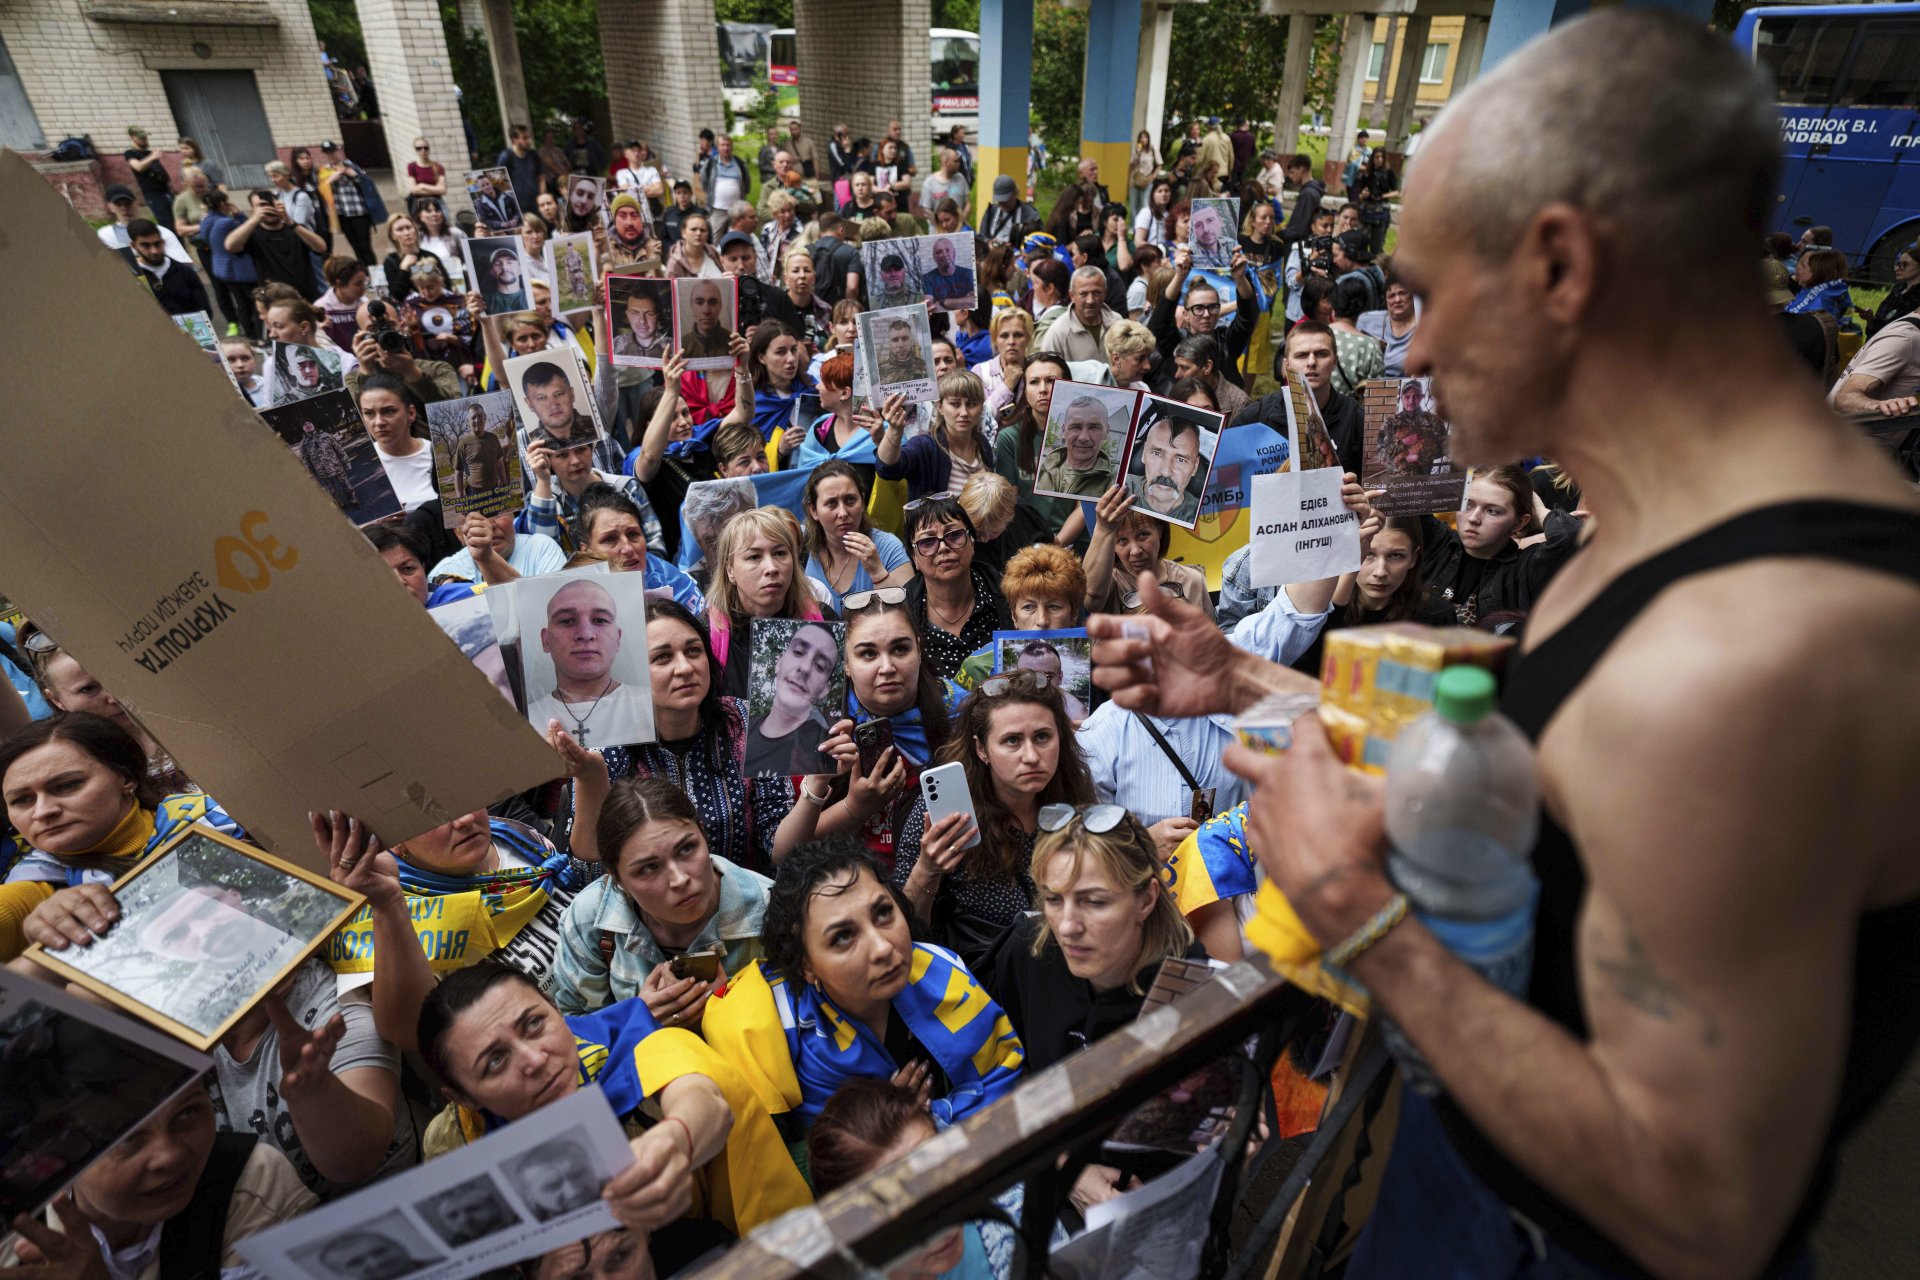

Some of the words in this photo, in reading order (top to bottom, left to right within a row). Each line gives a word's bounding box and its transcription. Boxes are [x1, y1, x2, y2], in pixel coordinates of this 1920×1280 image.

[1780, 131, 1848, 144] NDBAD
[1301, 498, 1328, 511] ЕДІЄВ
[1256, 522, 1297, 535] АСЛАН
[1301, 512, 1354, 531] АЛІХАНОВИЧ
[1295, 536, 1332, 553] (ІНГУШ)
[153, 571, 209, 623] ЗАВЖДИ
[115, 612, 160, 653] ПОРУЧ
[134, 593, 236, 675] УКРПОШТА
[328, 928, 375, 962] ВОЯ
[418, 929, 470, 962] ОНЯ
